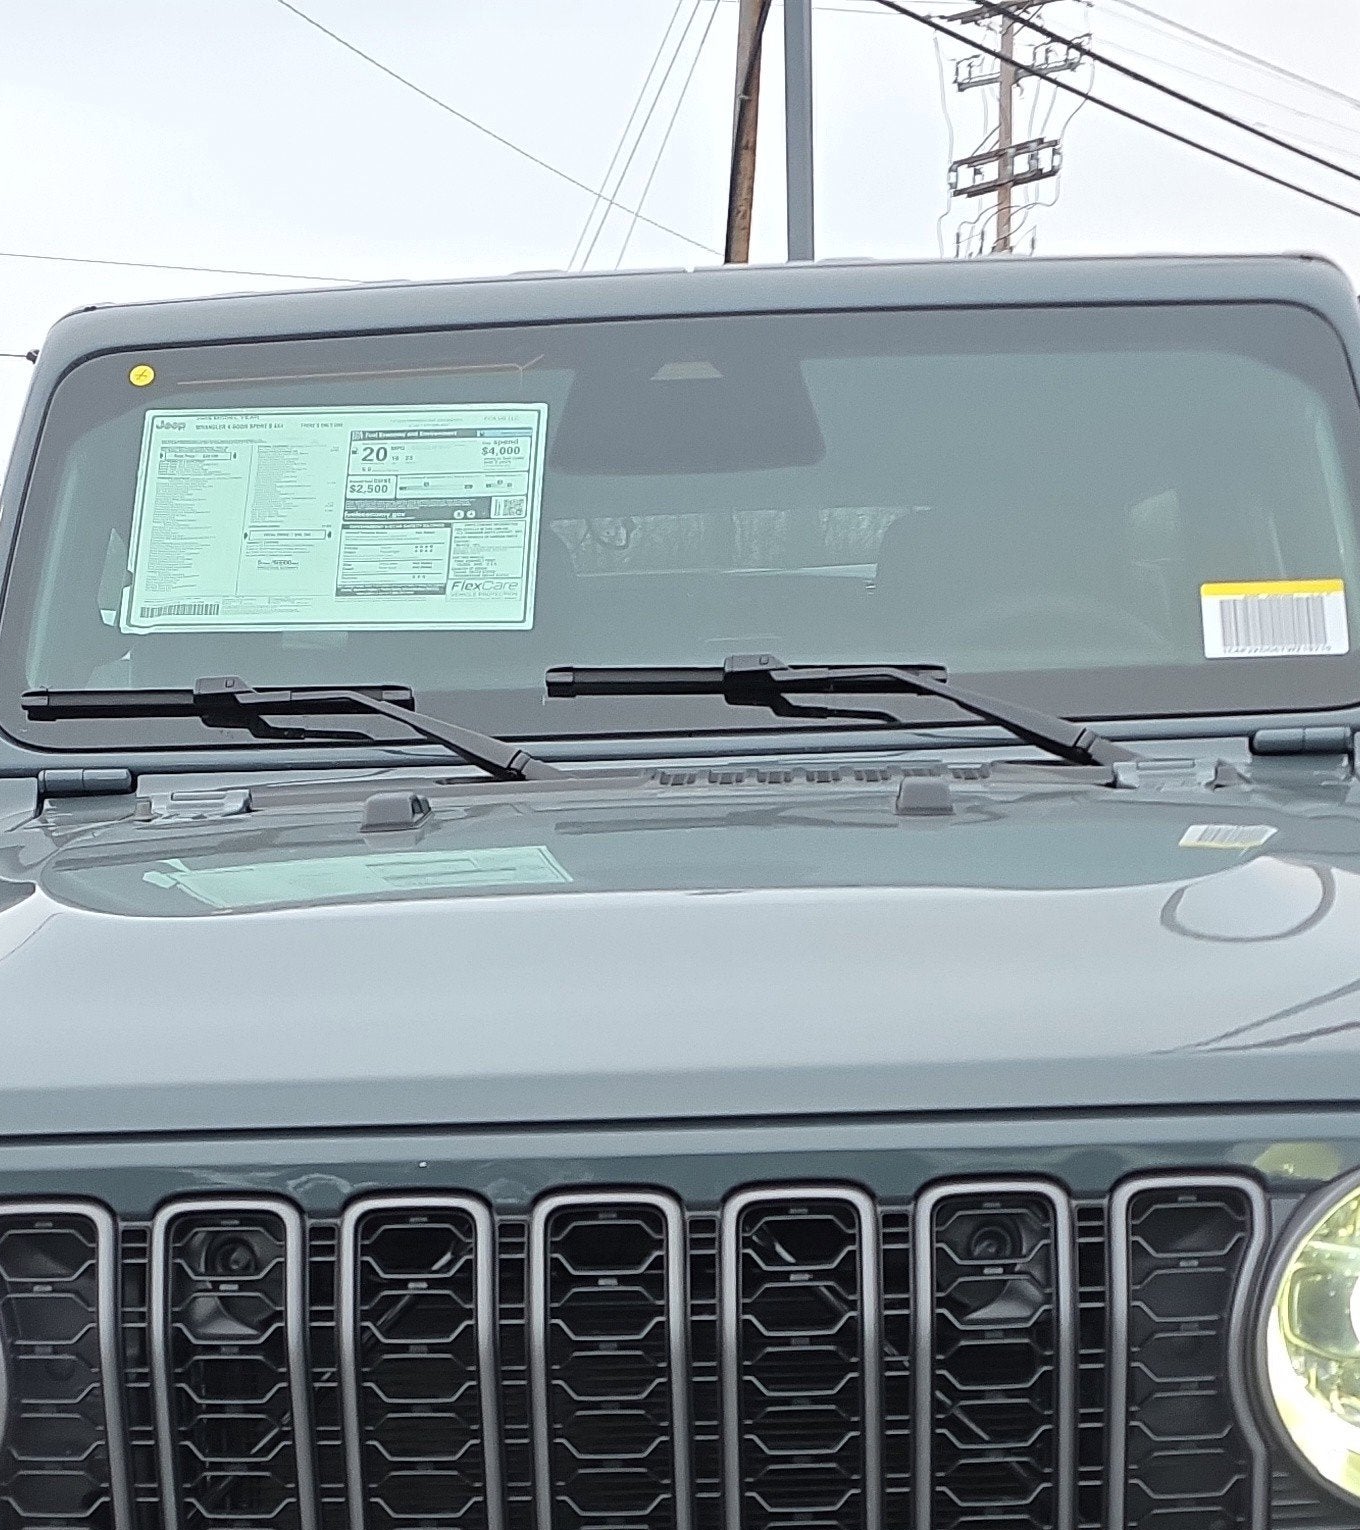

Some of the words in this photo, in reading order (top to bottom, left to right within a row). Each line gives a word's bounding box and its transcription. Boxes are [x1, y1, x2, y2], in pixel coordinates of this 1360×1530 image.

[155, 420, 187, 431] Jeep
[361, 446, 388, 462] 20
[481, 446, 521, 456] $4,000
[349, 484, 388, 493] $2,500
[451, 580, 519, 591] FlexCare
